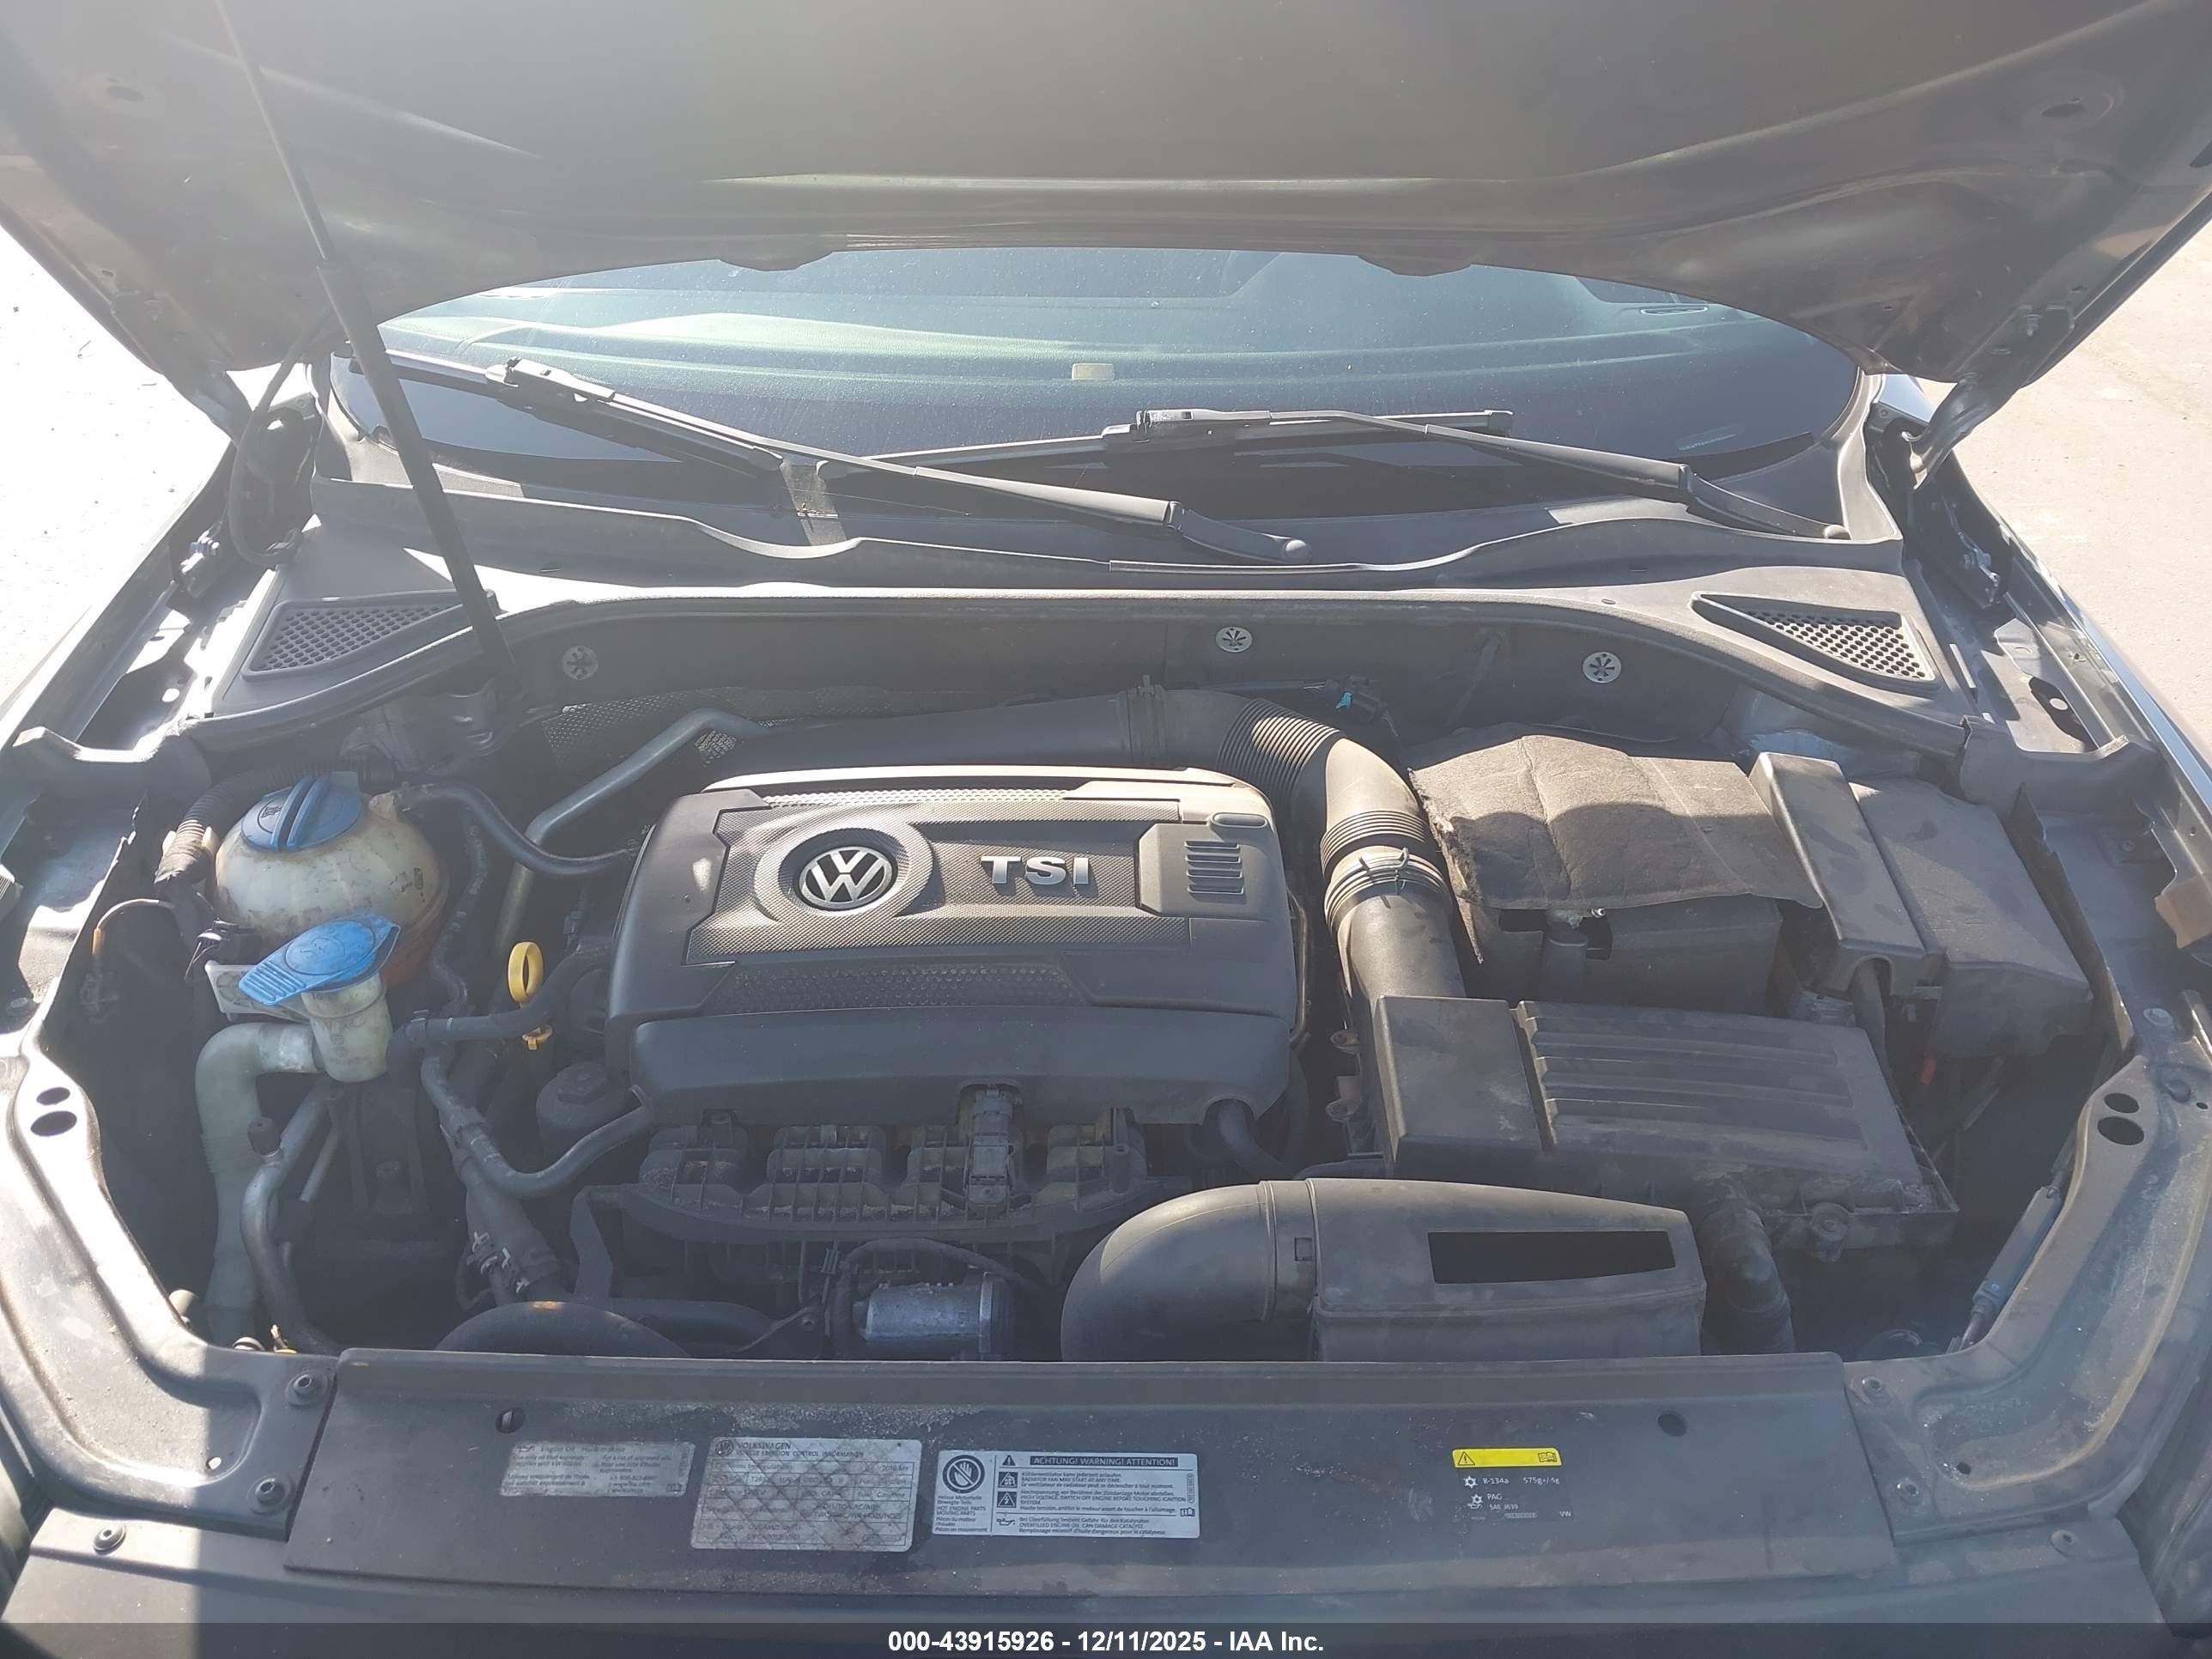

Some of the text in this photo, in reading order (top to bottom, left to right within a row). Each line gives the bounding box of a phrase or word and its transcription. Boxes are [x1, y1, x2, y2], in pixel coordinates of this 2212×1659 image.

[981, 856, 1089, 884] TSI
[737, 1442, 792, 1450] VOLKSWAGEN
[1033, 1456, 1176, 1467] ACHTUNG! WARNING! ATTENTION!
